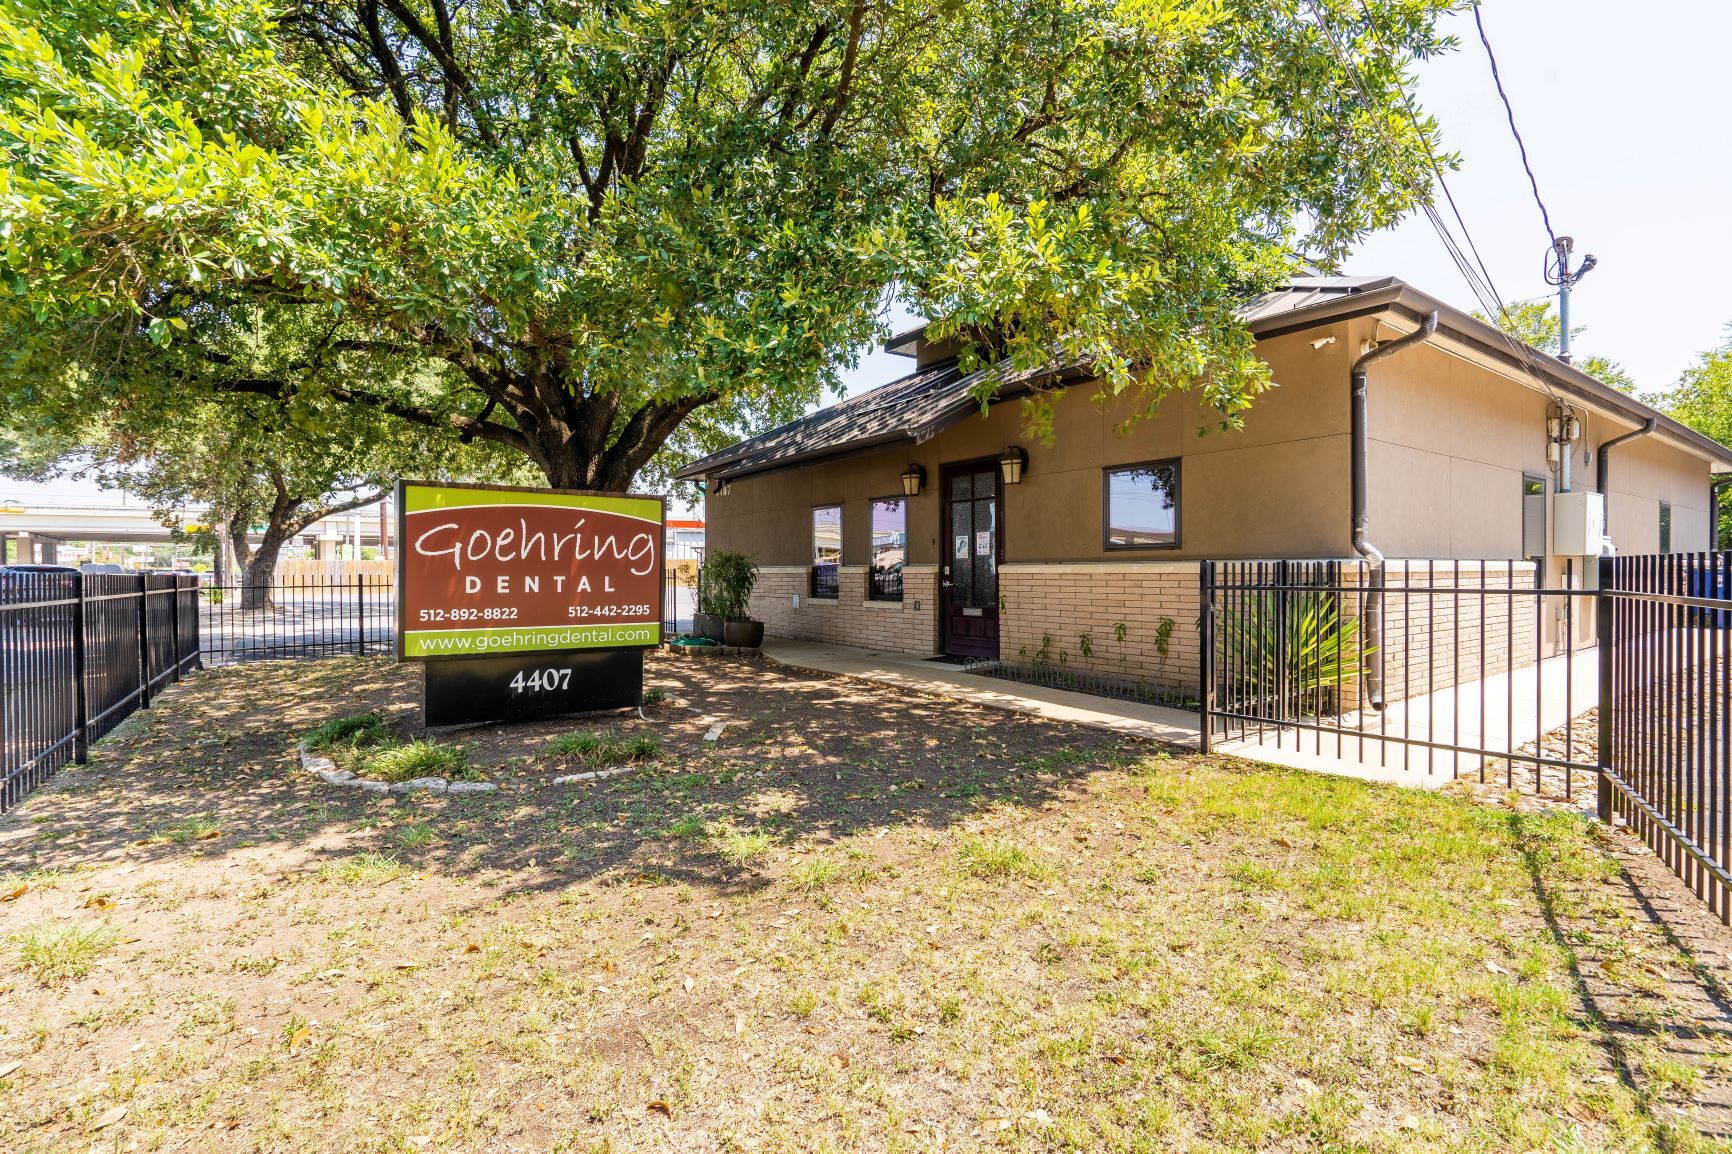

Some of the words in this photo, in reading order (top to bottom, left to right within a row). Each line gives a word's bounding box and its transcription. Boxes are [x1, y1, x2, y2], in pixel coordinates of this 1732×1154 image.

[465, 575, 615, 594] DENTAL
[419, 607, 518, 622] 512-892-8822
[568, 604, 650, 618] 512-442-2295
[419, 628, 650, 650] www.goehringdental.com
[509, 668, 572, 693] 4407
